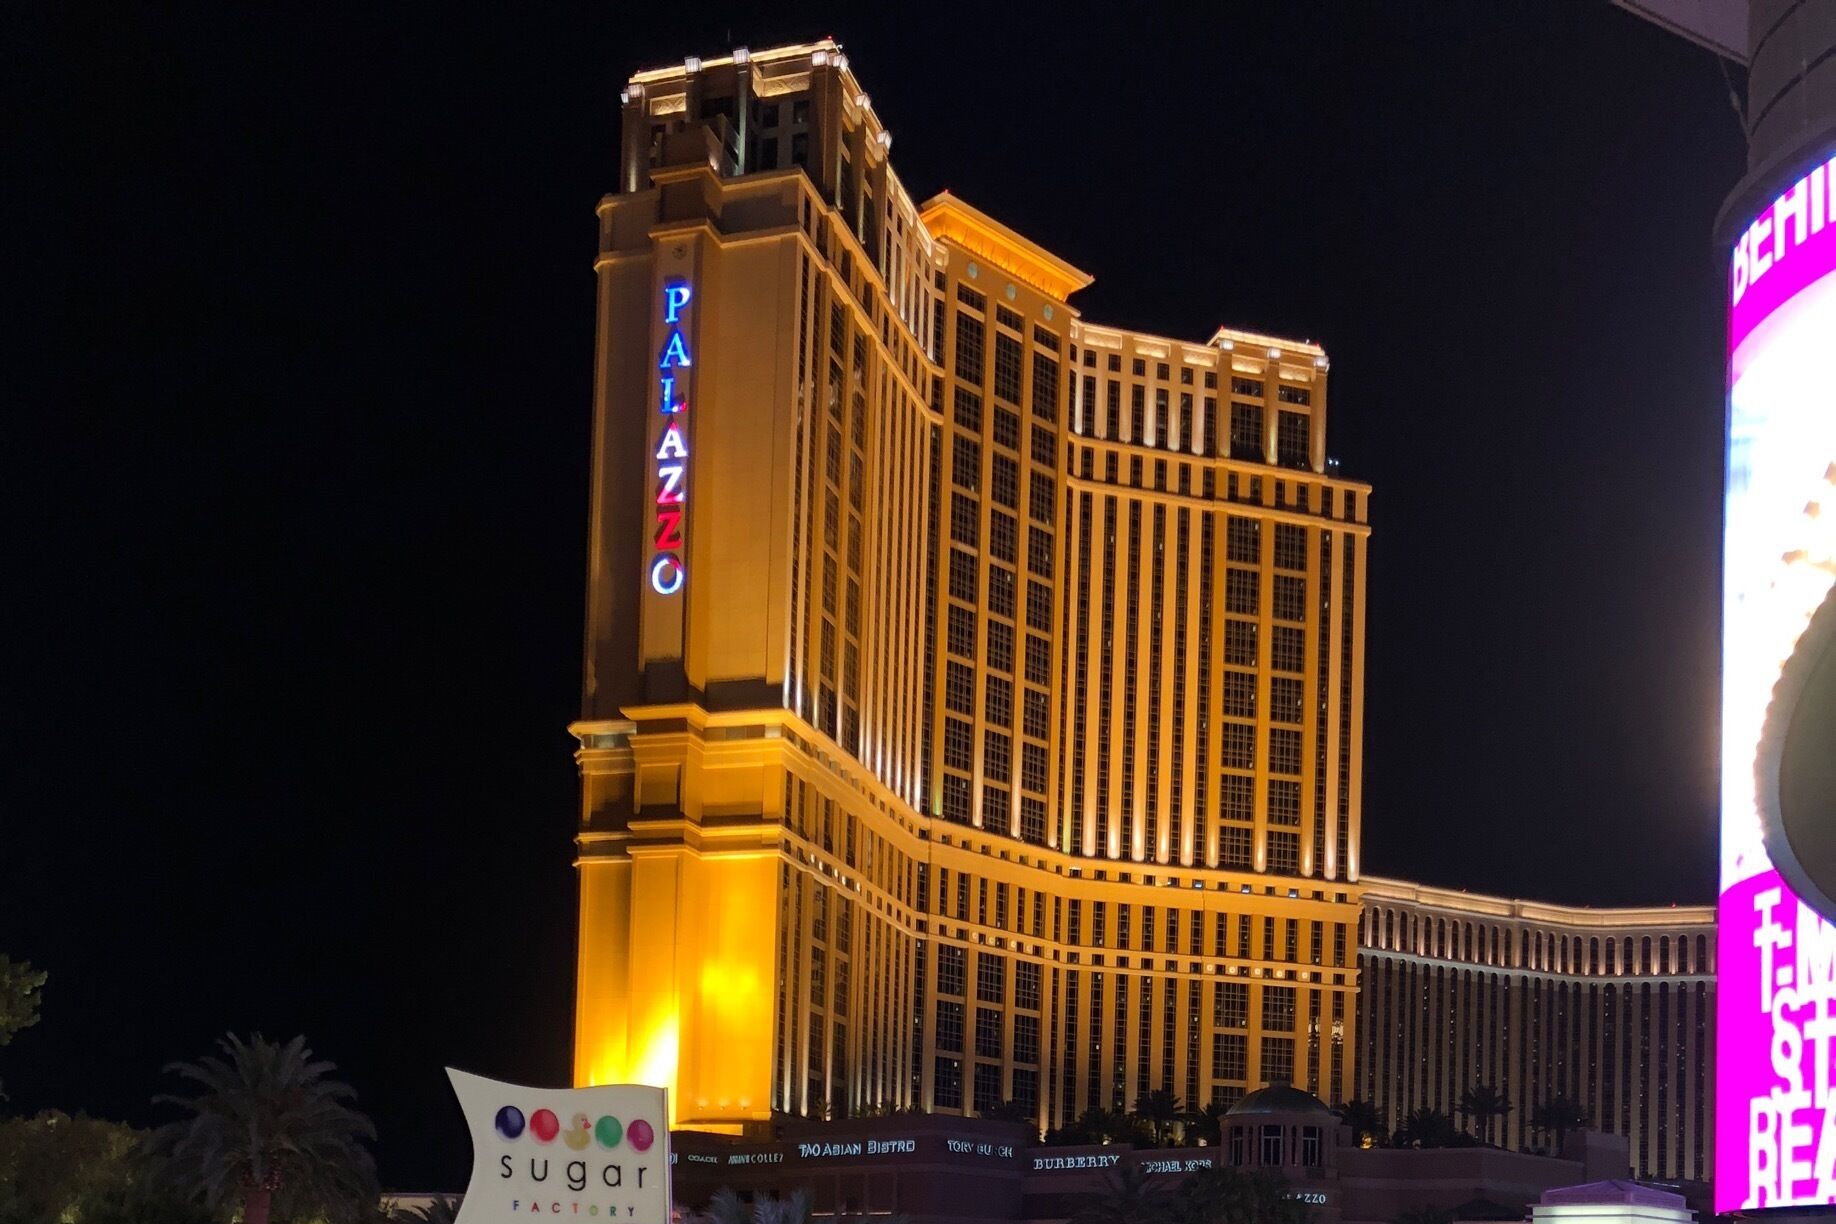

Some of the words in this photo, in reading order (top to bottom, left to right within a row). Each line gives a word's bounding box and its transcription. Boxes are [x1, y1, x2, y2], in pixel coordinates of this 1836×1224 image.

[651, 285, 693, 595] PALAZZO
[799, 1143, 821, 1157] TAO
[823, 1142, 861, 1157] ASIAN
[867, 1139, 916, 1154] BISTRO
[947, 1139, 974, 1153] TORY
[1033, 1155, 1121, 1170] BURBERRY
[500, 1154, 648, 1192] sugar
[512, 1199, 635, 1217] FACTORY
